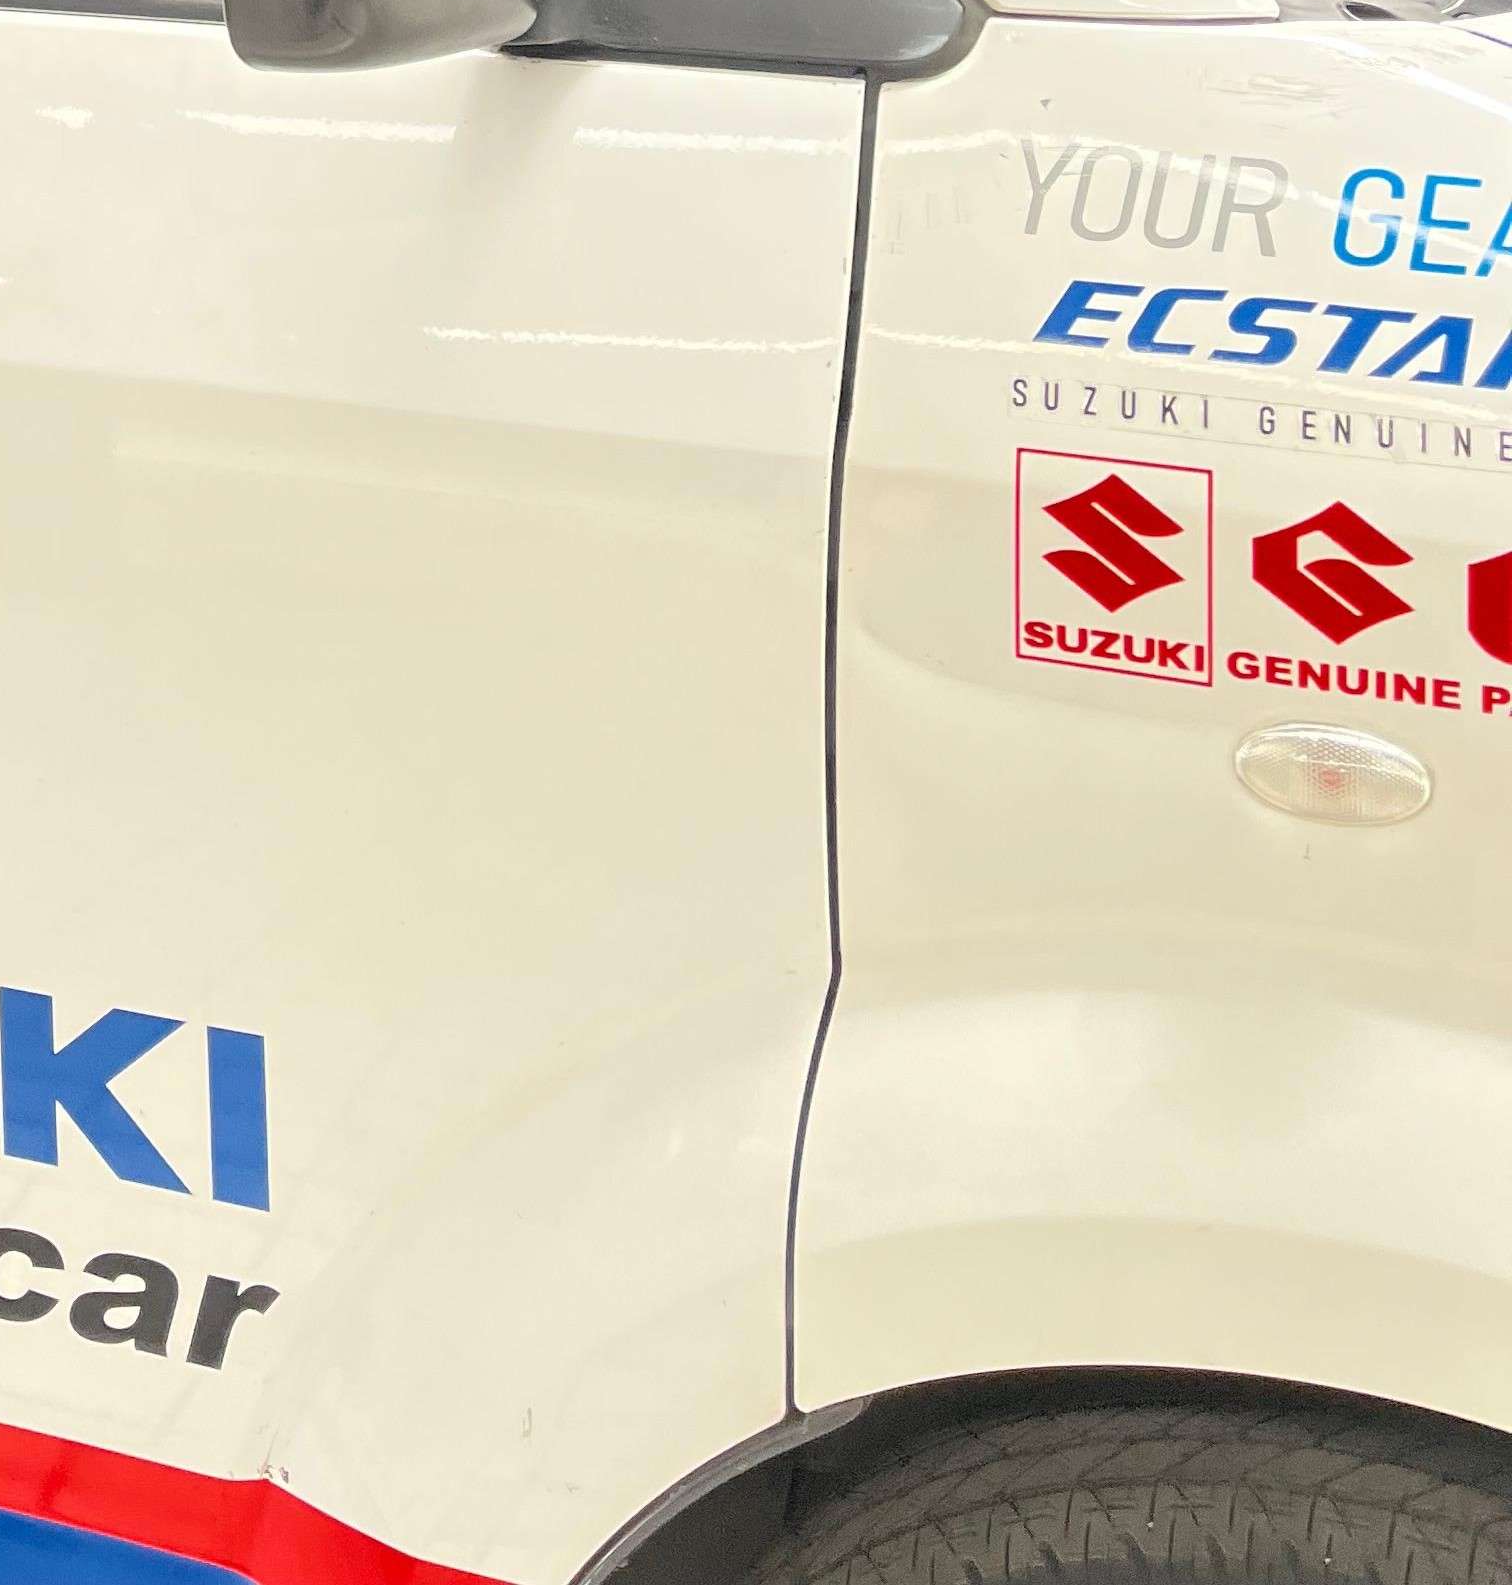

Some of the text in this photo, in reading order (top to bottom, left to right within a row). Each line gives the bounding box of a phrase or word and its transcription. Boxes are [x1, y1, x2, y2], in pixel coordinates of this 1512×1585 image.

[1020, 138, 1289, 258] YOUR
[1011, 378, 1512, 461] SUZUKI GENUINE
[1022, 620, 1512, 716] SUZUKI GENUINE P
